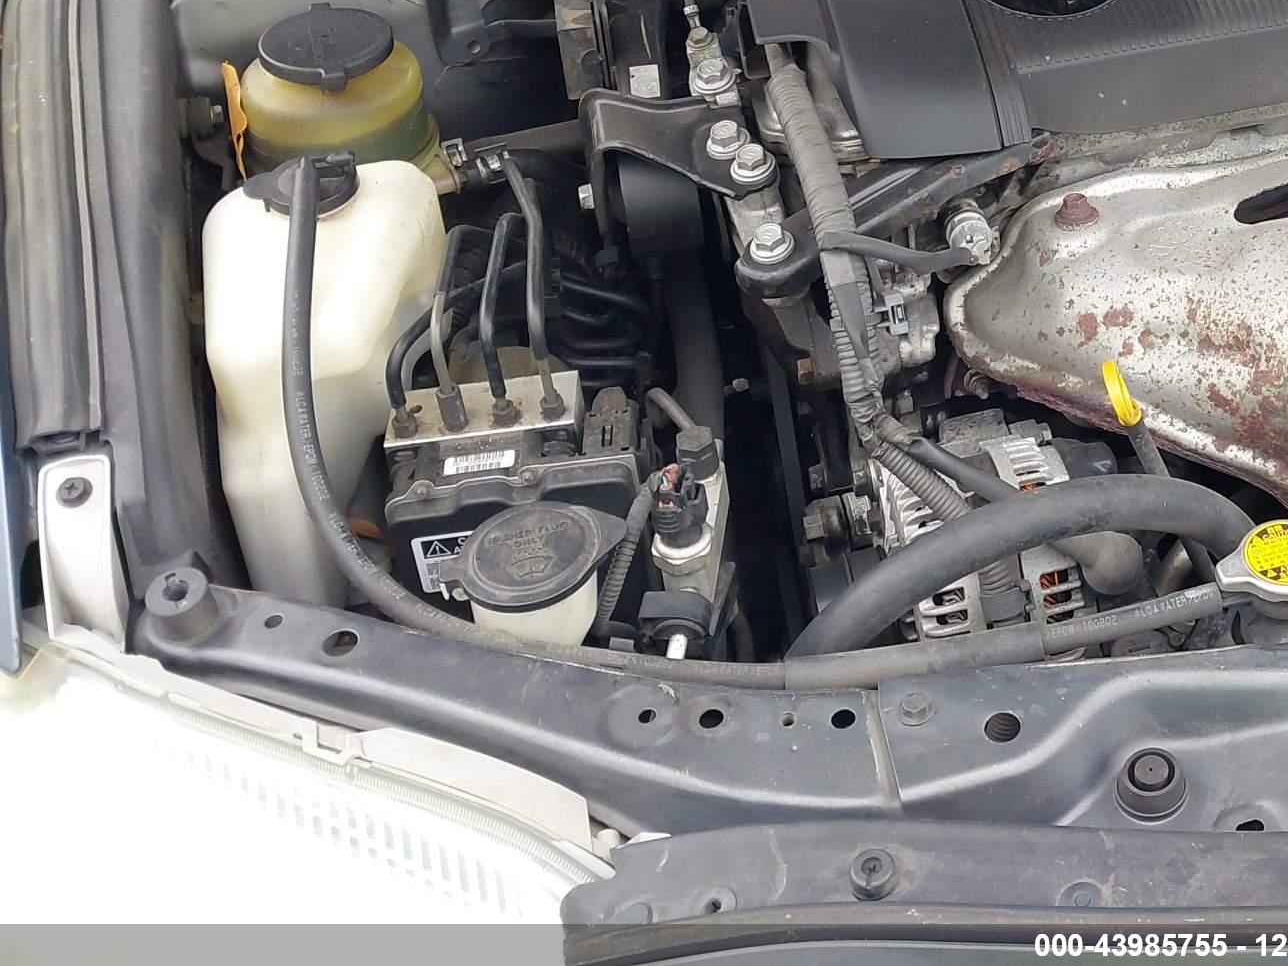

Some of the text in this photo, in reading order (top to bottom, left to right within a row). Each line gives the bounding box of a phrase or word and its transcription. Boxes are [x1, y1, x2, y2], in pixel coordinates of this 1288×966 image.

[538, 521, 569, 535] FLUID
[513, 535, 545, 548] ONLY
[1082, 614, 1120, 631] 100202
